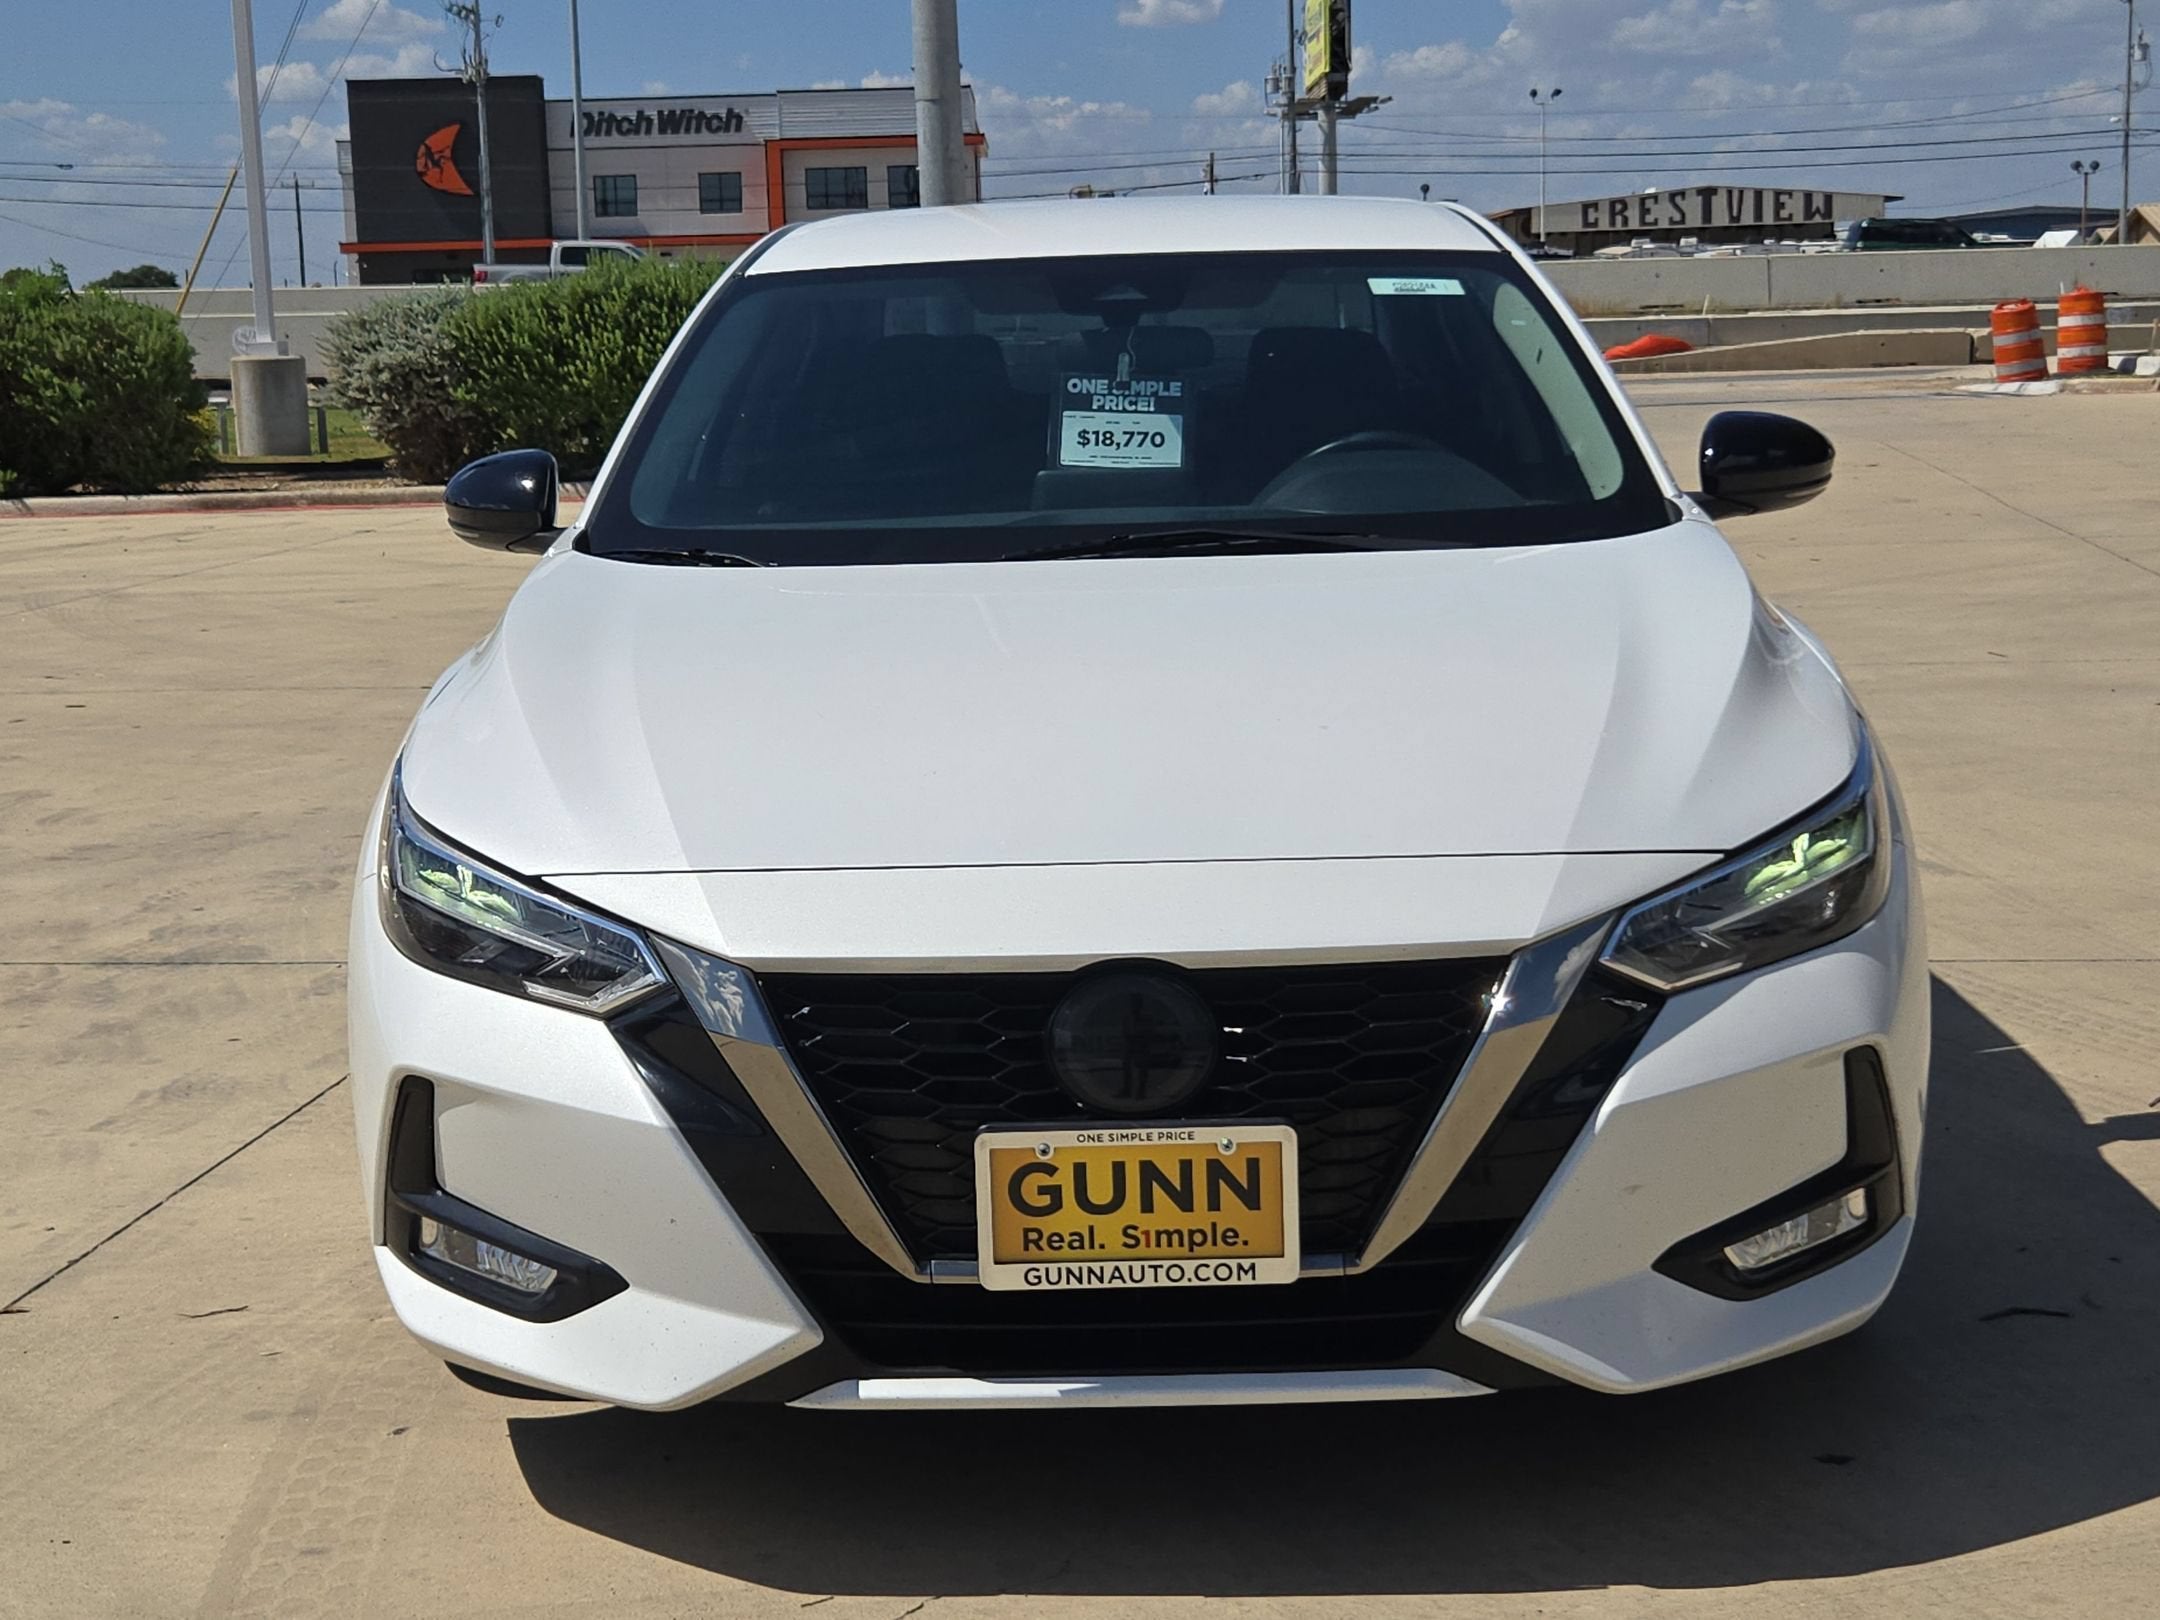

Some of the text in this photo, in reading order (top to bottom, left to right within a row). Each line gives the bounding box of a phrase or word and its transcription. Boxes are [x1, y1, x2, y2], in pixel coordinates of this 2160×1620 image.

[570, 107, 744, 137] Ditch Witch
[1581, 187, 1833, 228] CRESTVIEW
[1066, 378, 1182, 397] ONE SMPLE
[1092, 395, 1156, 412] PRICE!
[1076, 428, 1165, 451] $18,770
[1076, 1130, 1195, 1144] ONE SIMPLE PRICE
[1007, 1157, 1262, 1218] GUNN
[1023, 1225, 1106, 1252] Real.
[1023, 1262, 1257, 1287] GUNNAUTO.COM
